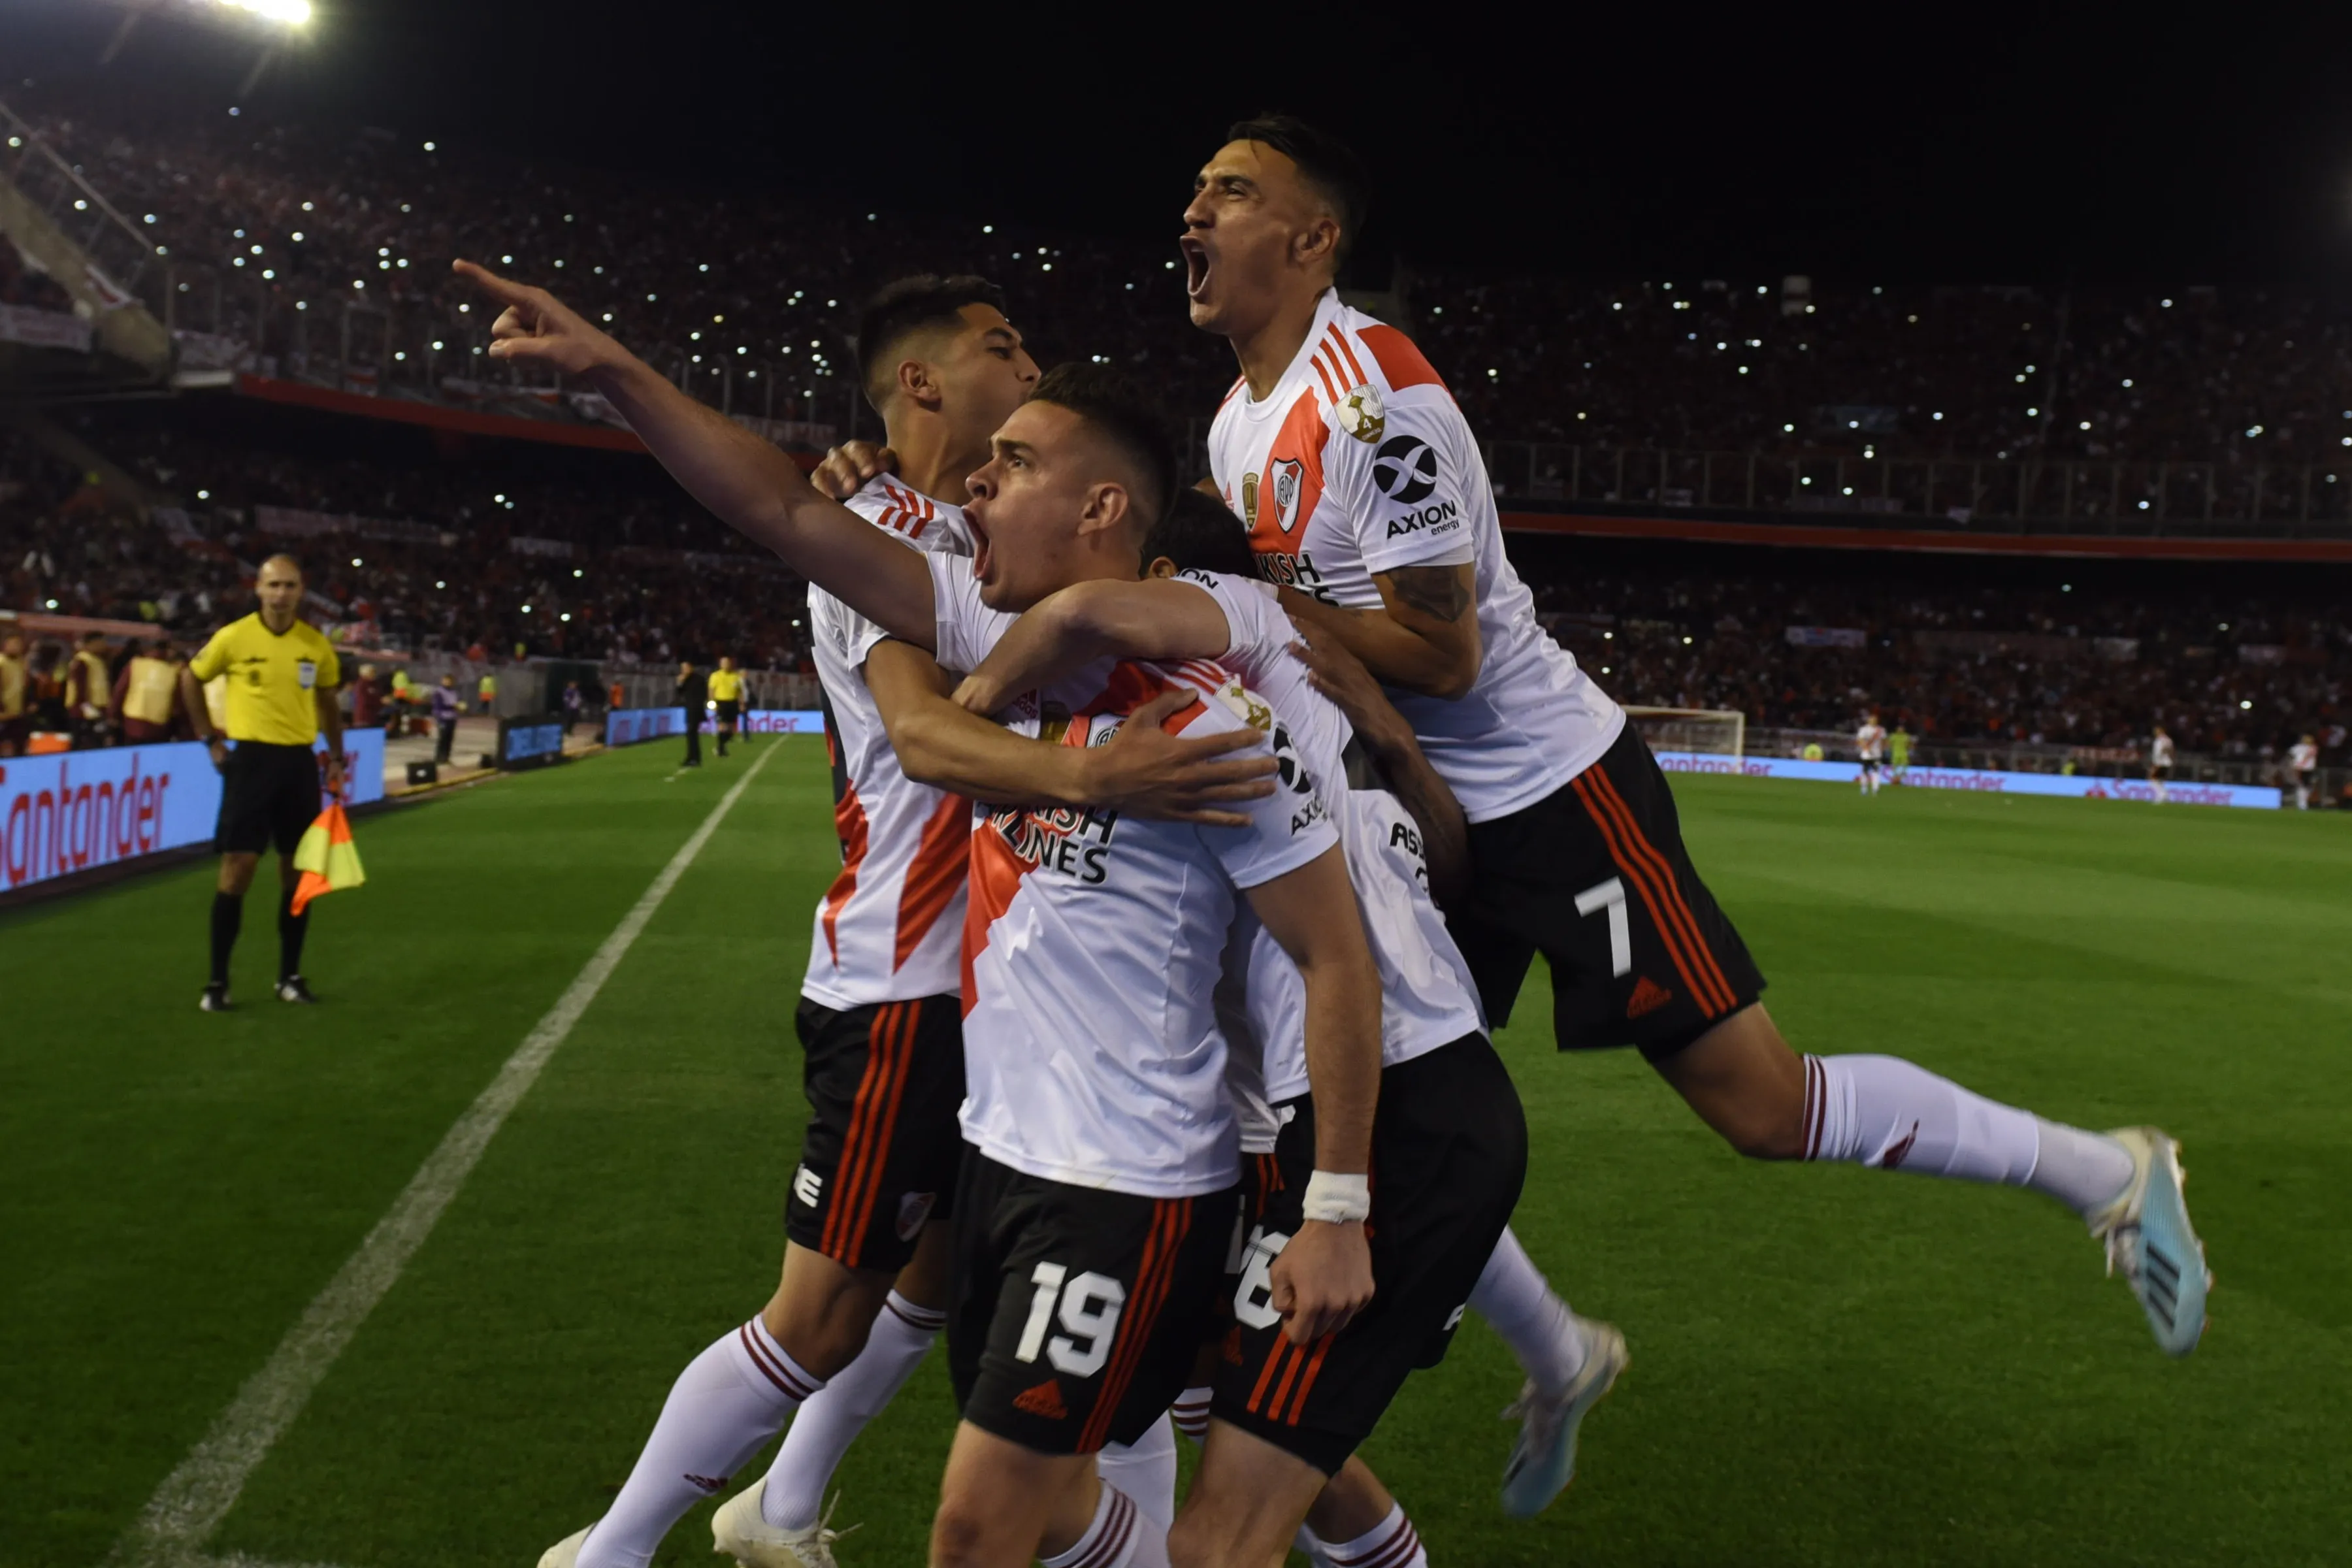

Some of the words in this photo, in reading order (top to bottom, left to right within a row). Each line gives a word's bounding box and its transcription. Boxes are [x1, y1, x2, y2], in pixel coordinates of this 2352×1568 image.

[1387, 500, 1456, 540] AXION
[1431, 519, 1460, 536] energy
[1655, 751, 1773, 777] antander
[0, 753, 169, 886] antander
[1573, 875, 1631, 979] 7
[1015, 1261, 1126, 1379] 19
[1233, 1224, 1292, 1330] 6
